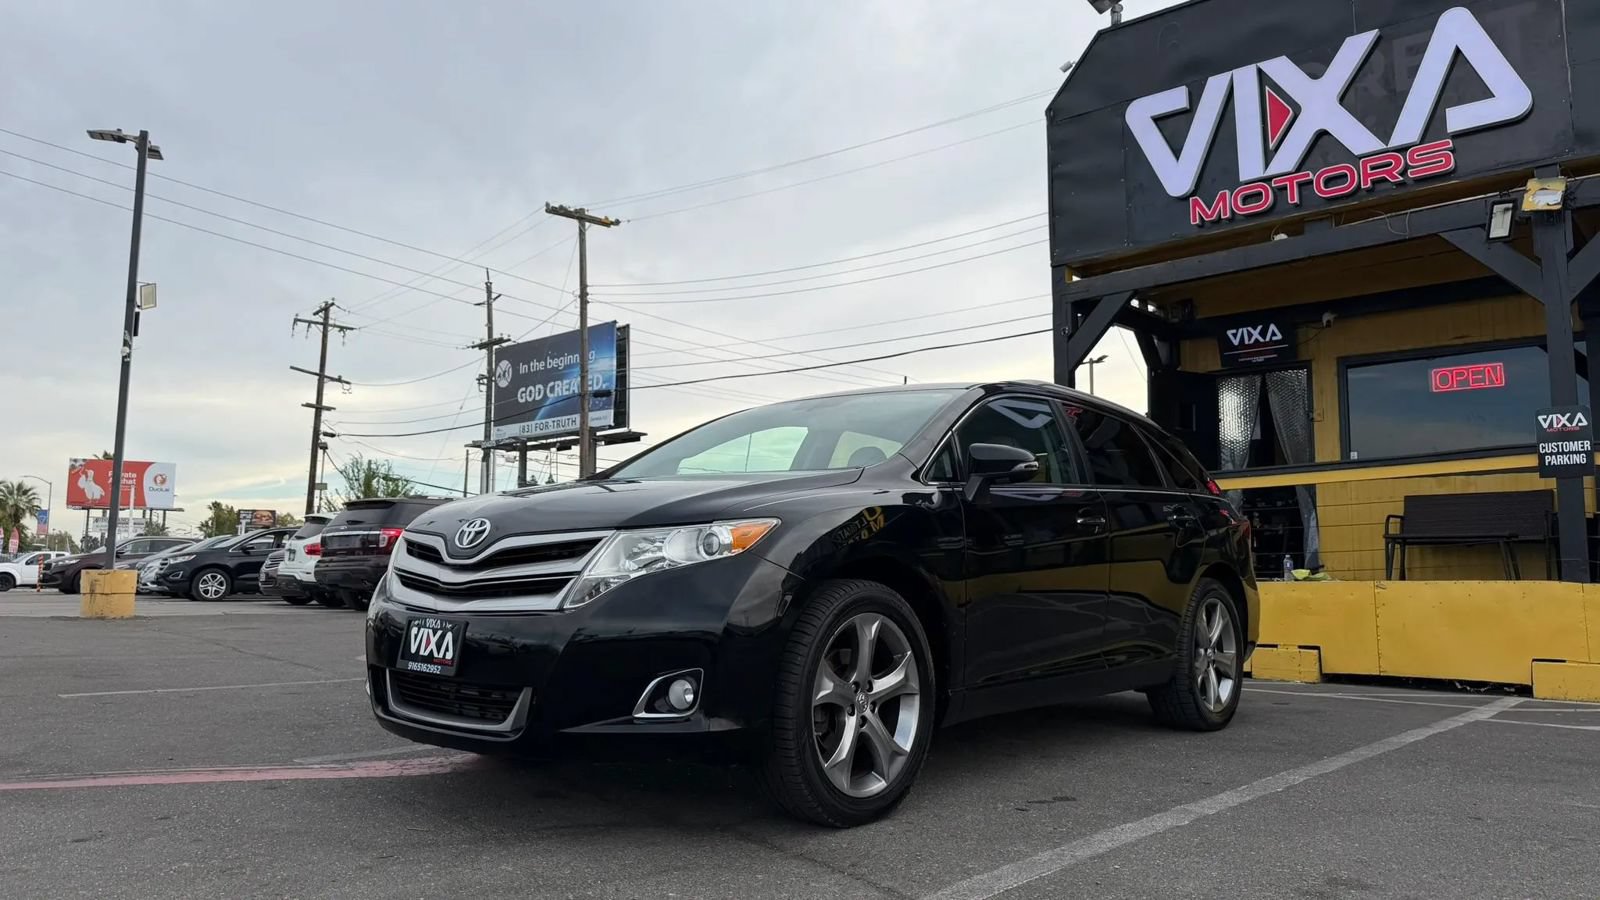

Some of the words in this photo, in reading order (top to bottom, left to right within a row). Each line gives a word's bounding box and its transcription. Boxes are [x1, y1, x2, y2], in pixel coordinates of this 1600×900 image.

[1125, 6, 1534, 198] VIXA
[1189, 139, 1456, 226] MOTORS
[1226, 323, 1283, 346] VIXA
[519, 362, 529, 375] In
[530, 359, 545, 373] the
[546, 350, 596, 370] beginng
[517, 384, 544, 403] GOD
[546, 374, 606, 397] CREAED.
[1436, 365, 1502, 390] OPEN
[534, 417, 577, 432] FOR-TRUTH
[1537, 412, 1588, 429] VIXA
[1539, 440, 1591, 454] CUSTOMER
[1545, 453, 1587, 466] PARKING
[410, 626, 454, 660] VIXA
[407, 661, 442, 674] 9165162952
